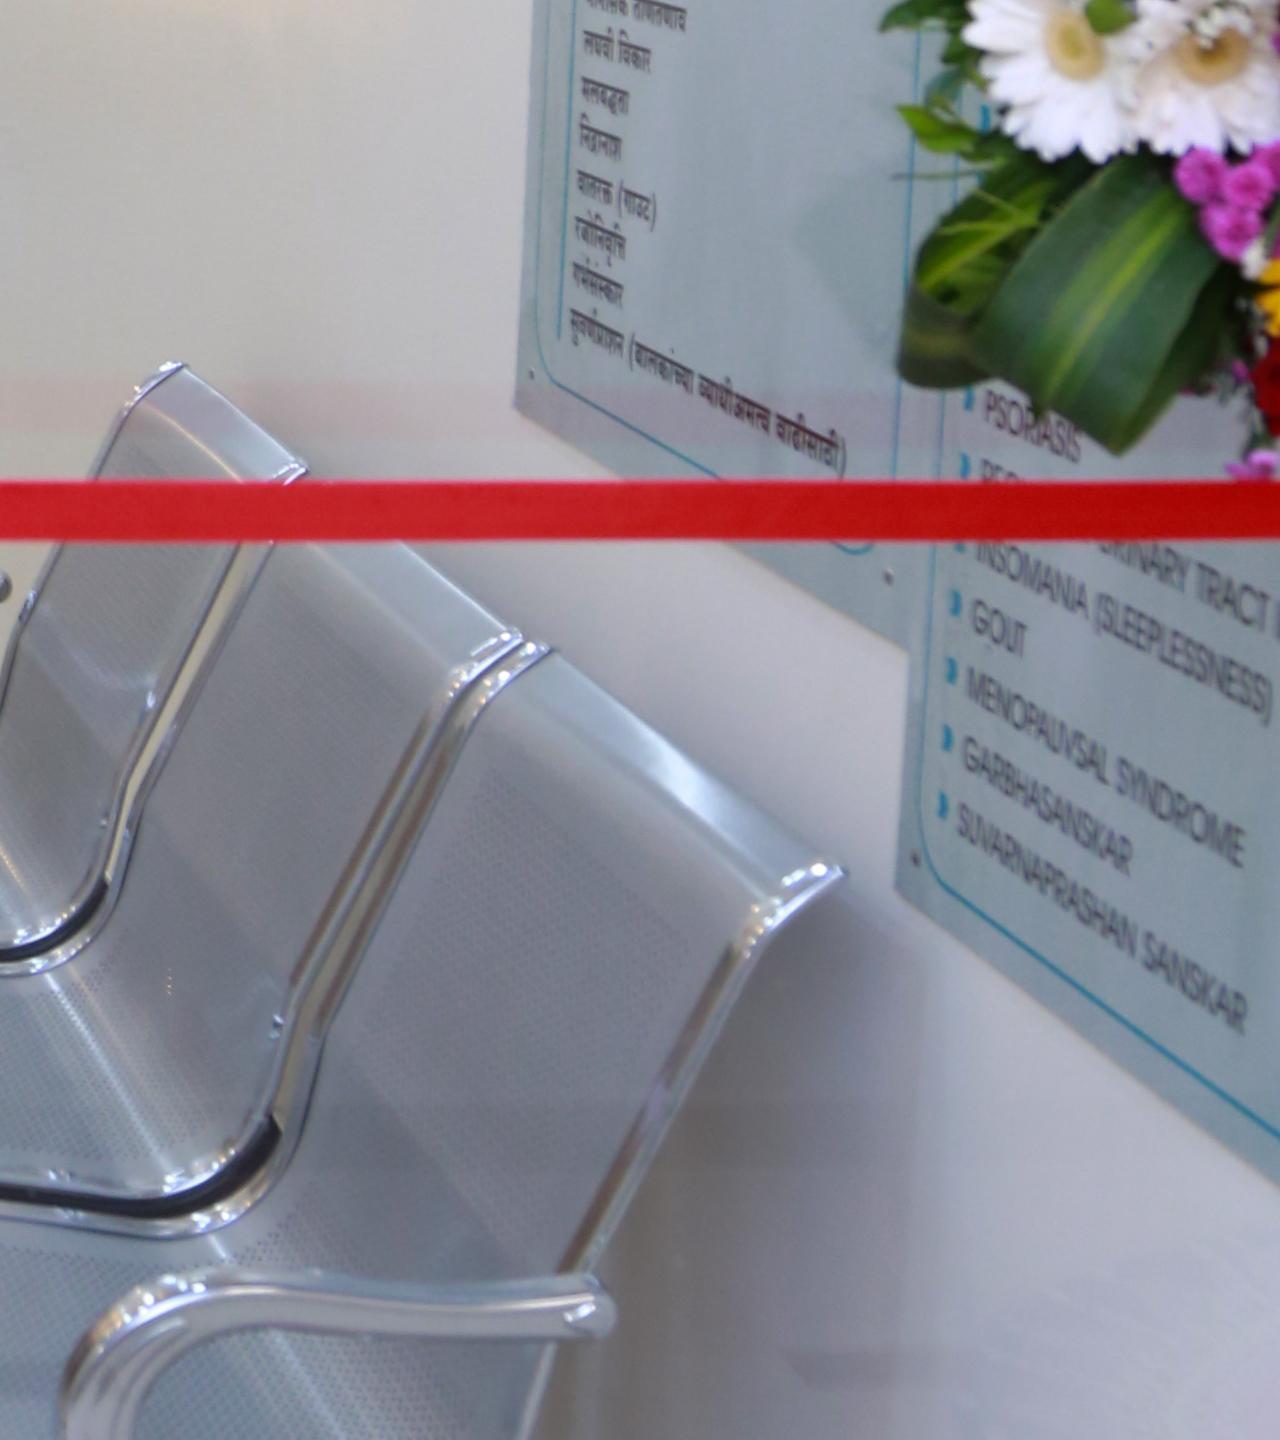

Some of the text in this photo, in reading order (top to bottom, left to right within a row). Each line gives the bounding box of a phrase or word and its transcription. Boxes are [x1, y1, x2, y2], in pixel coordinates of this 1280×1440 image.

[617, 29, 651, 72] विकार
[972, 597, 1028, 657] GOUT
[1196, 558, 1270, 632] TRACT
[963, 735, 1133, 877] GARBHASANSKAR
[1116, 757, 1246, 870] SYNDROME
[957, 801, 1248, 1035] SUVARNAPRASHAN SANSKAR
